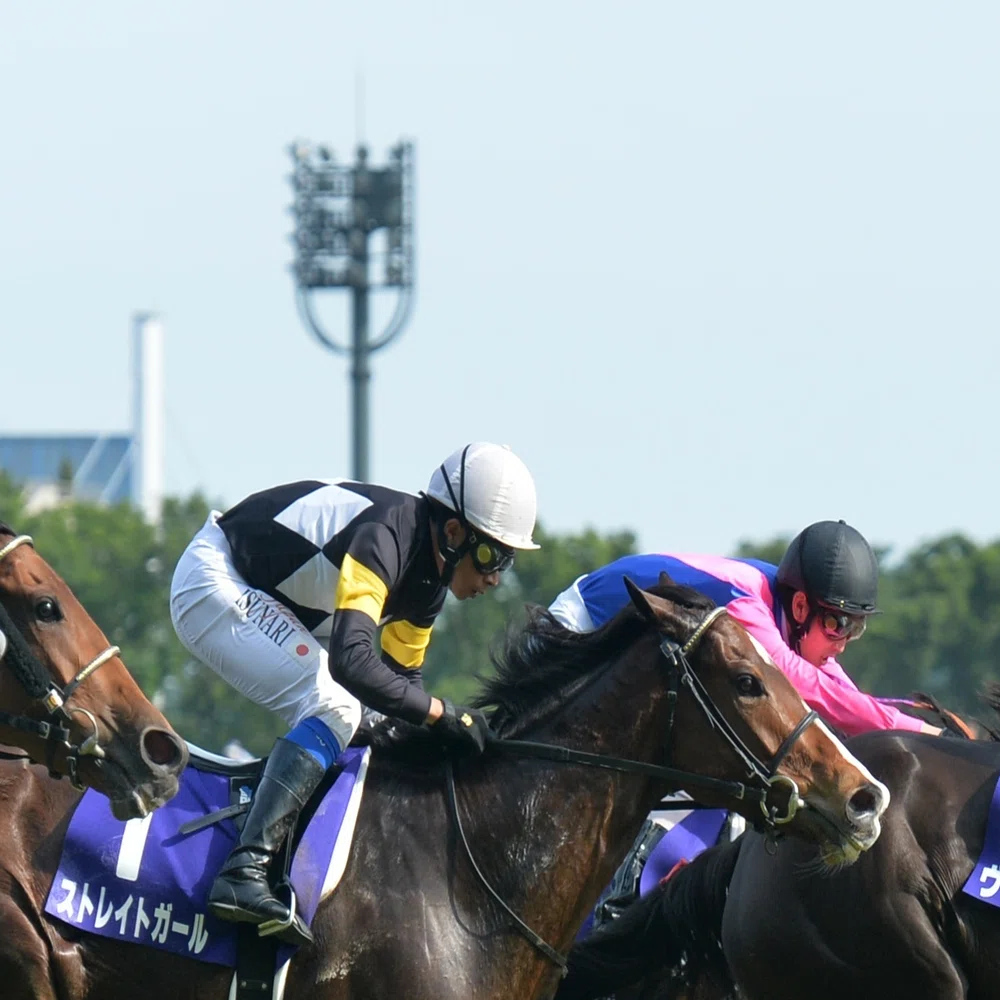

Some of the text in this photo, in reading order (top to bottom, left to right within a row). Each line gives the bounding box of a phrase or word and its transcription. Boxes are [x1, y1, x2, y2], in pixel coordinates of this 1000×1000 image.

[115, 811, 154, 882] 1
[56, 877, 209, 954] ストレイトガール
